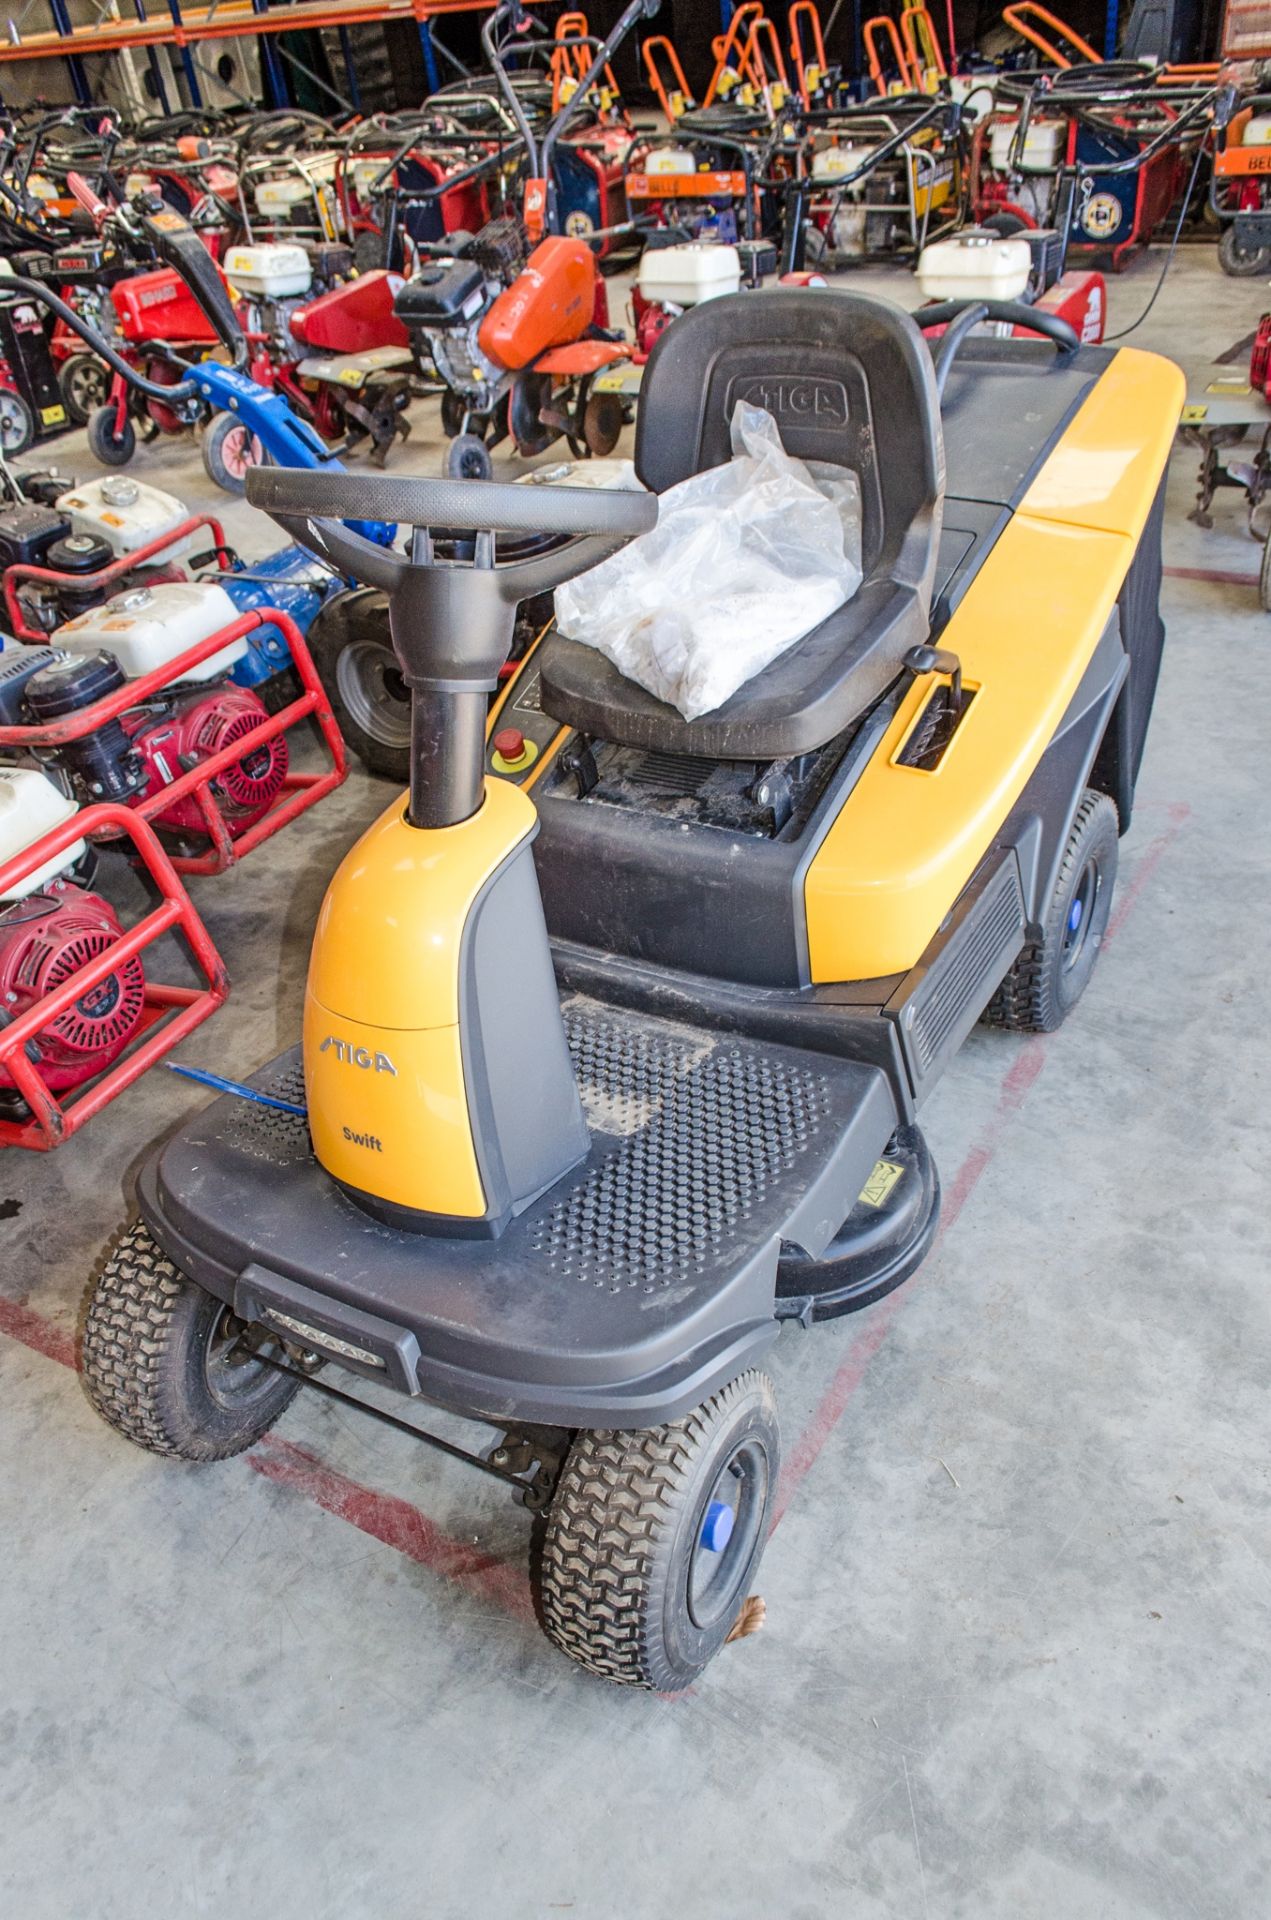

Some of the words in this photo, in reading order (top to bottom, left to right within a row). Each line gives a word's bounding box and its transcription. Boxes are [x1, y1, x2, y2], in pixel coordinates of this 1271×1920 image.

[743, 384, 841, 419] STIGA
[319, 1035, 399, 1077] STIGA
[342, 1126, 384, 1153] Swift
